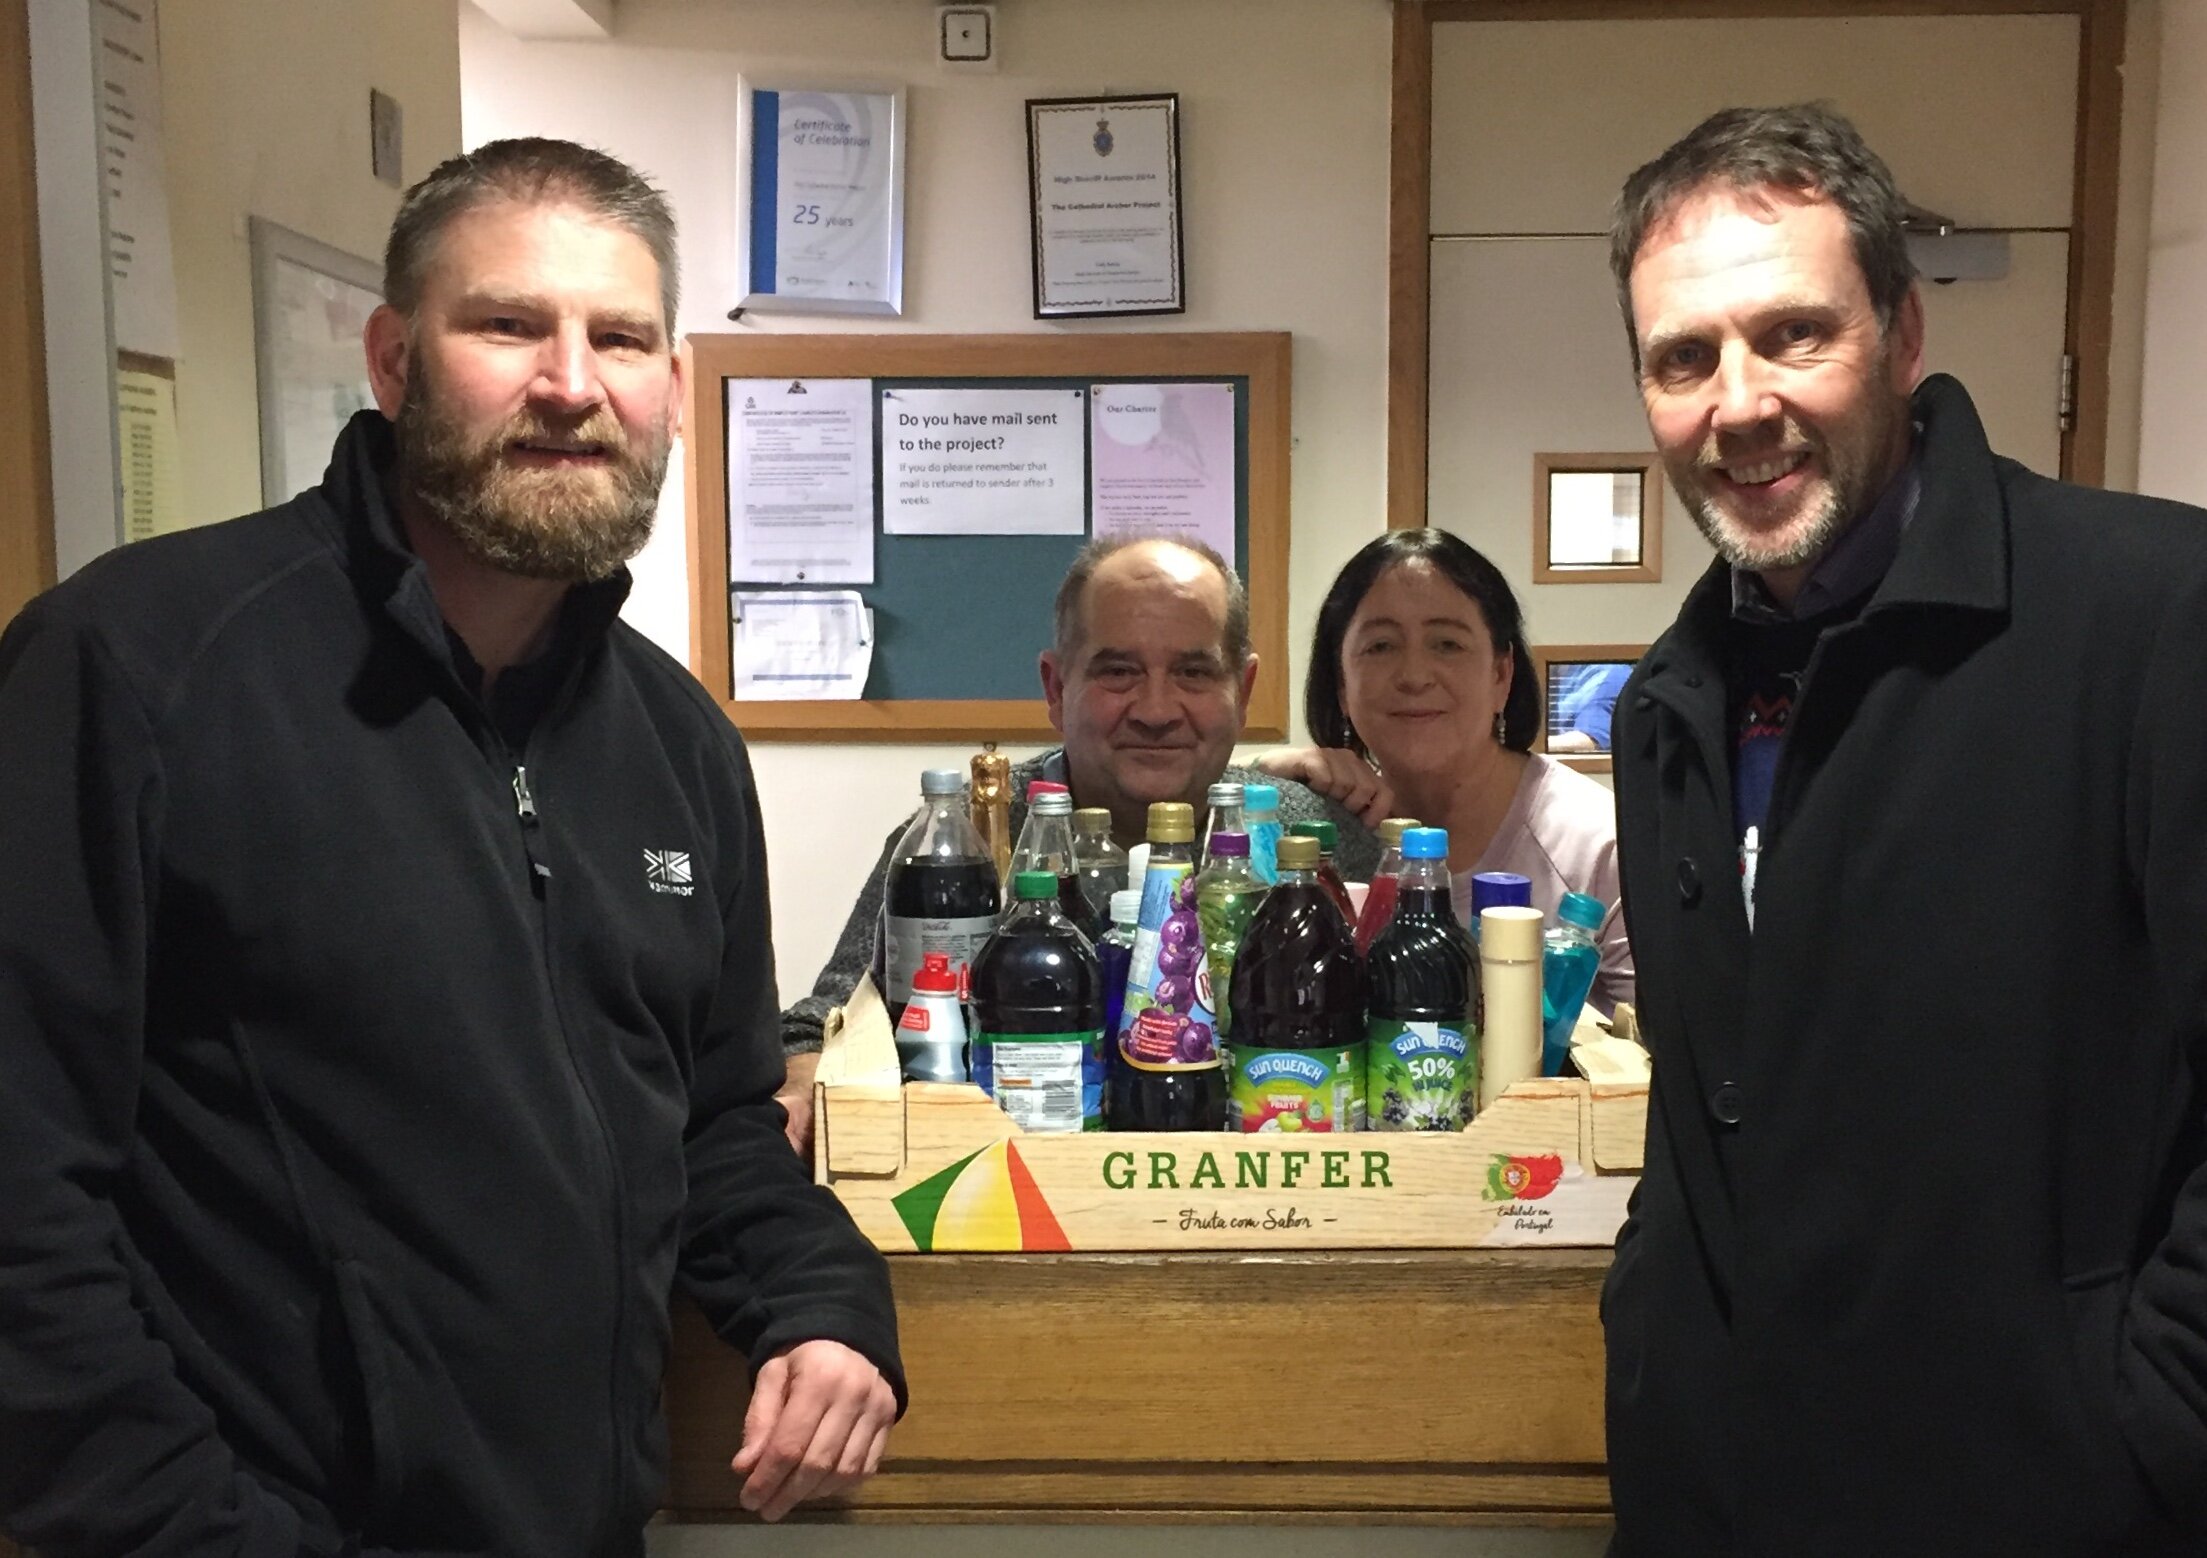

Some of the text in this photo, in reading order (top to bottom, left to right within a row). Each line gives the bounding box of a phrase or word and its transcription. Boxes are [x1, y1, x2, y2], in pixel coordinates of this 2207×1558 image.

[793, 117, 852, 132] Certificate
[793, 133, 871, 146] of Celebration
[792, 204, 854, 228] 25 years
[1106, 405, 1123, 413] Our
[899, 412, 1058, 428] Do you have mail sent
[899, 437, 1005, 453] to the project?
[899, 462, 1047, 474] If you do please remember that
[899, 478, 1055, 489] mail is returned to sender after 3
[1396, 1036, 1421, 1056] SUN
[1248, 1058, 1323, 1081] SUN QUENCH
[1407, 1057, 1456, 1080] 50%
[1102, 1150, 1393, 1189] GRANFER
[1179, 1206, 1312, 1231] Fruta com Sabor
